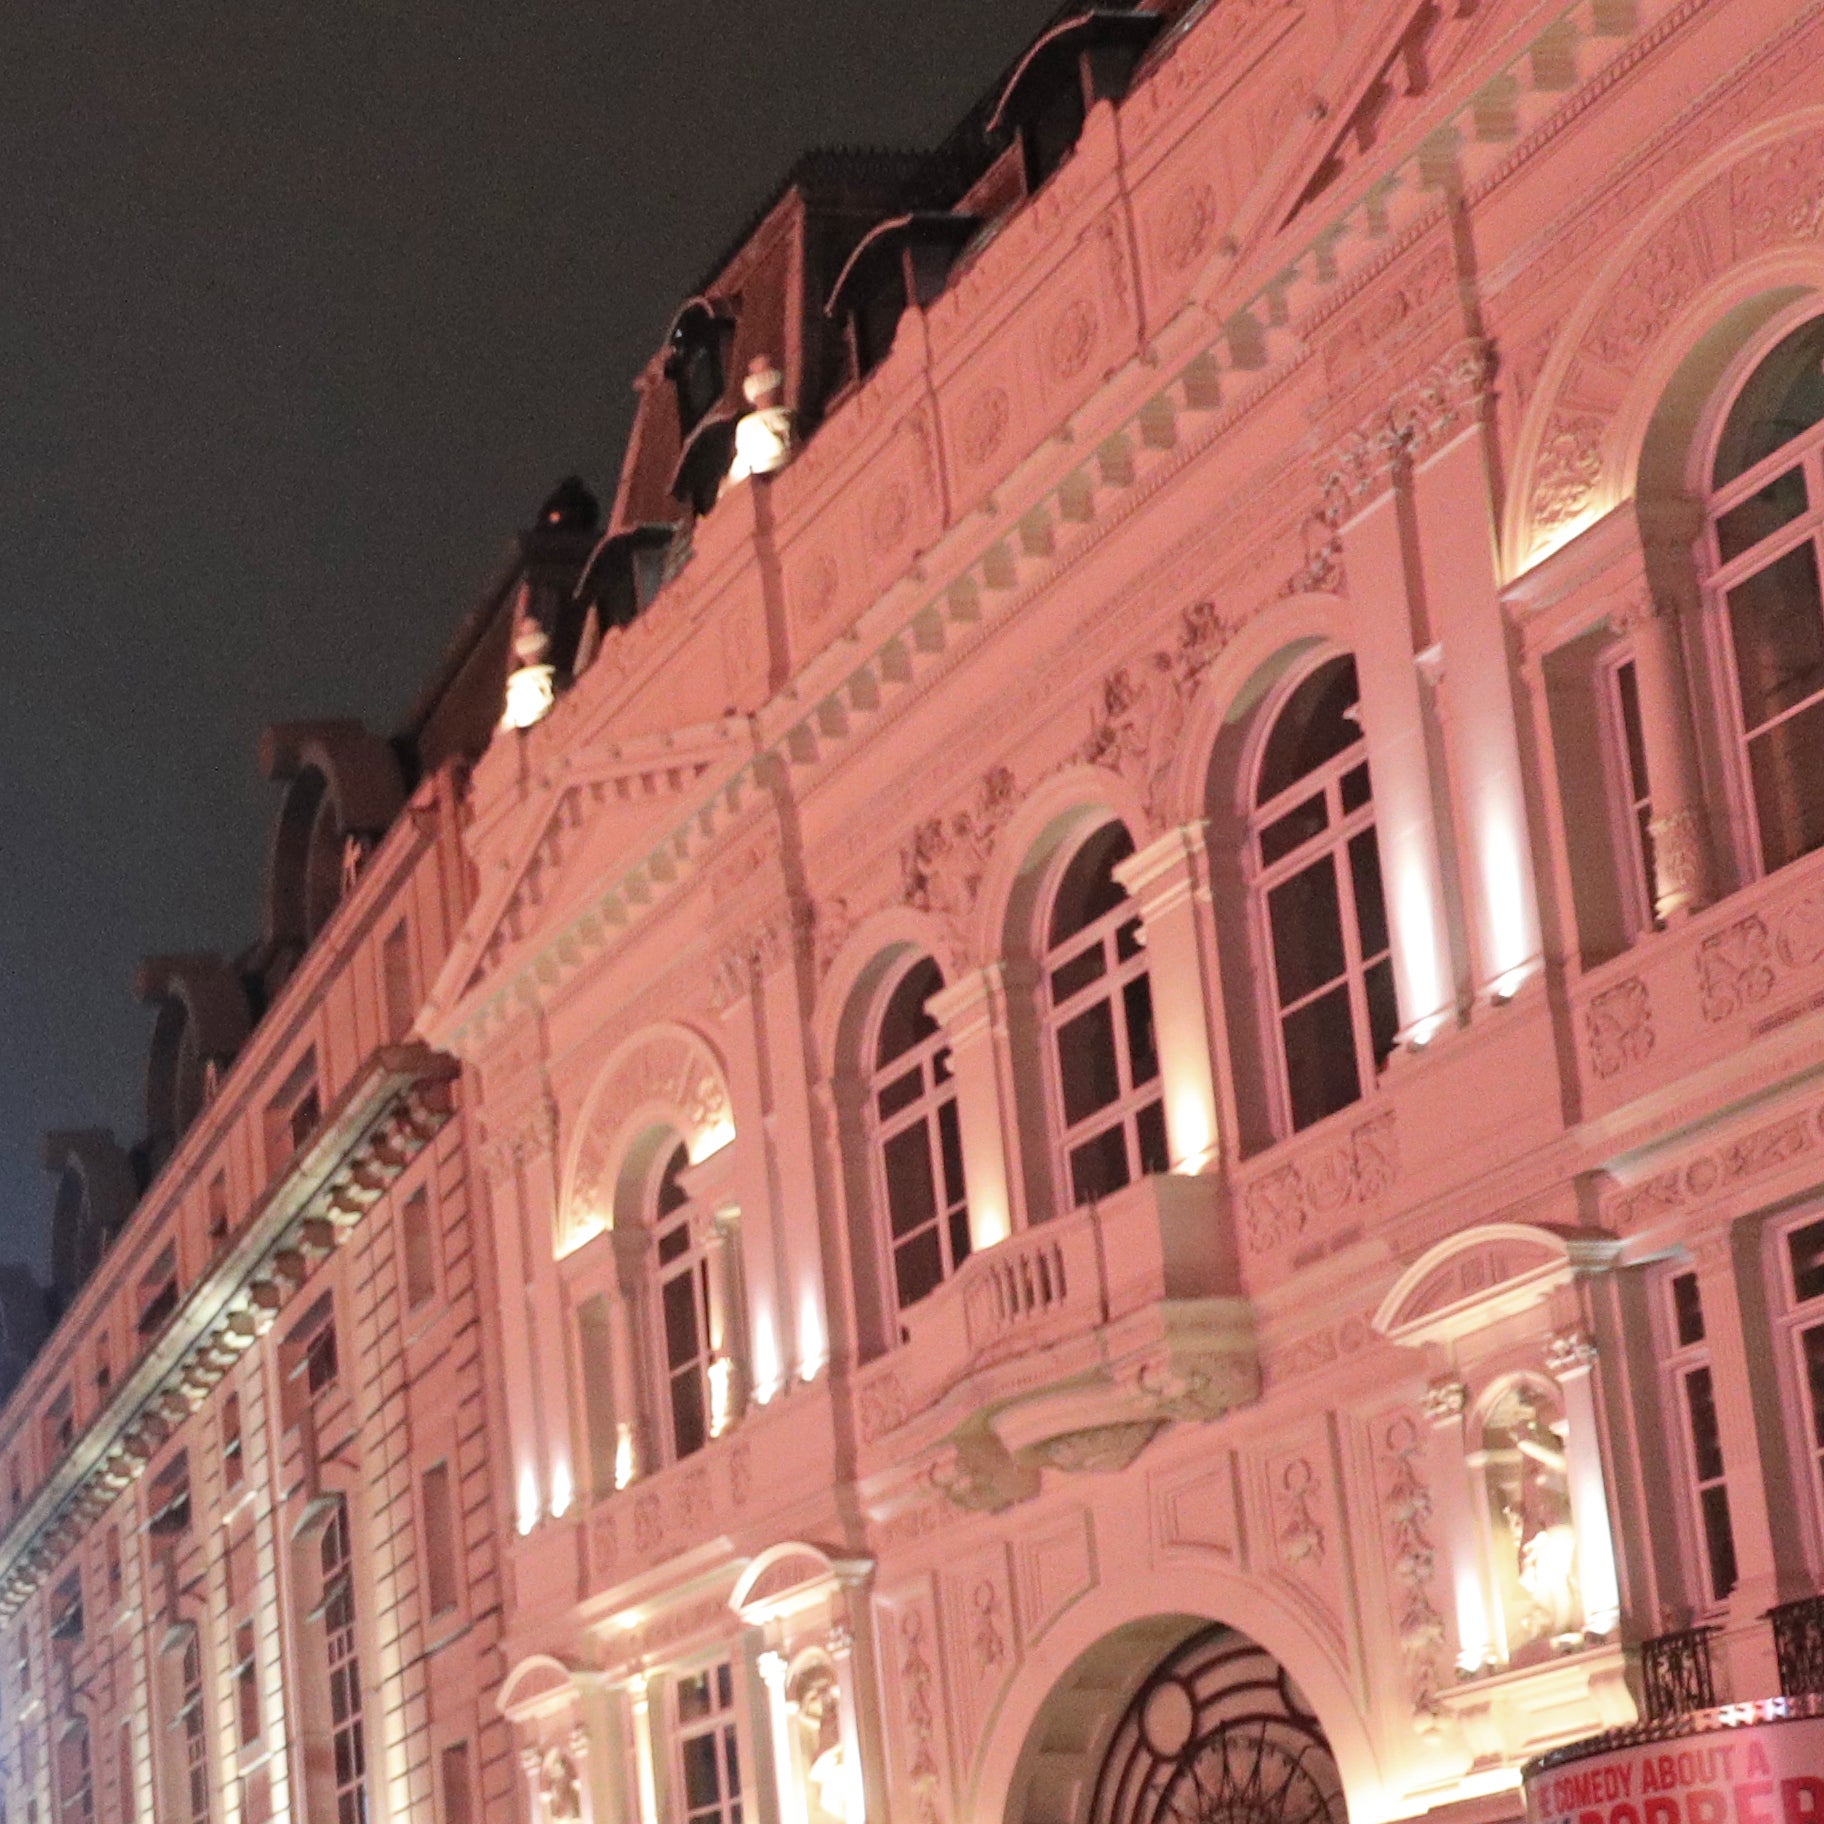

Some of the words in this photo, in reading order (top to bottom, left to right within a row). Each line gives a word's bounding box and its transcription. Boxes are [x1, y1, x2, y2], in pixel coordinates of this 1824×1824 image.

[1555, 1763, 1634, 1814] COMEDY
[1642, 1744, 1736, 1795] ABOUT
[1748, 1738, 1770, 1777] A
